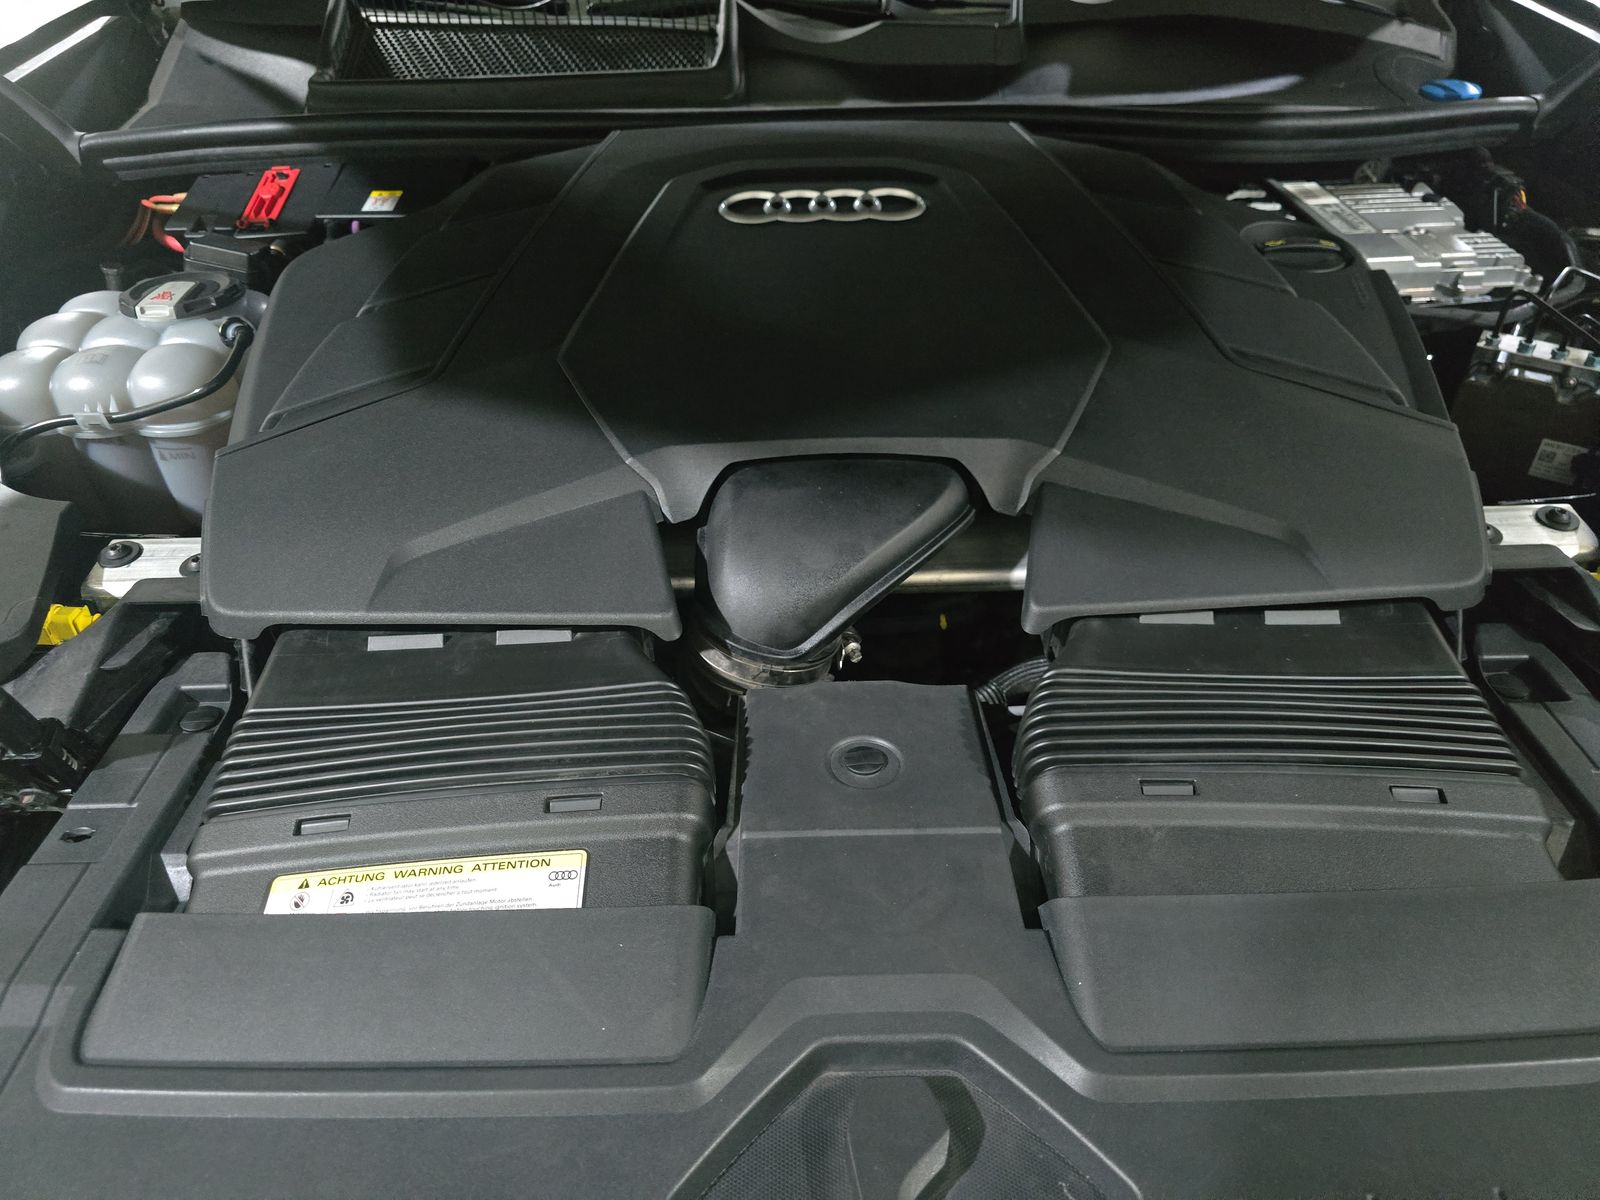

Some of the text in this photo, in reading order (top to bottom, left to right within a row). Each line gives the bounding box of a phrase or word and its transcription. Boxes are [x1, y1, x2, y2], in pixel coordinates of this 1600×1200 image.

[317, 858, 552, 886] ACHTUNG WARNING ATTENTION
